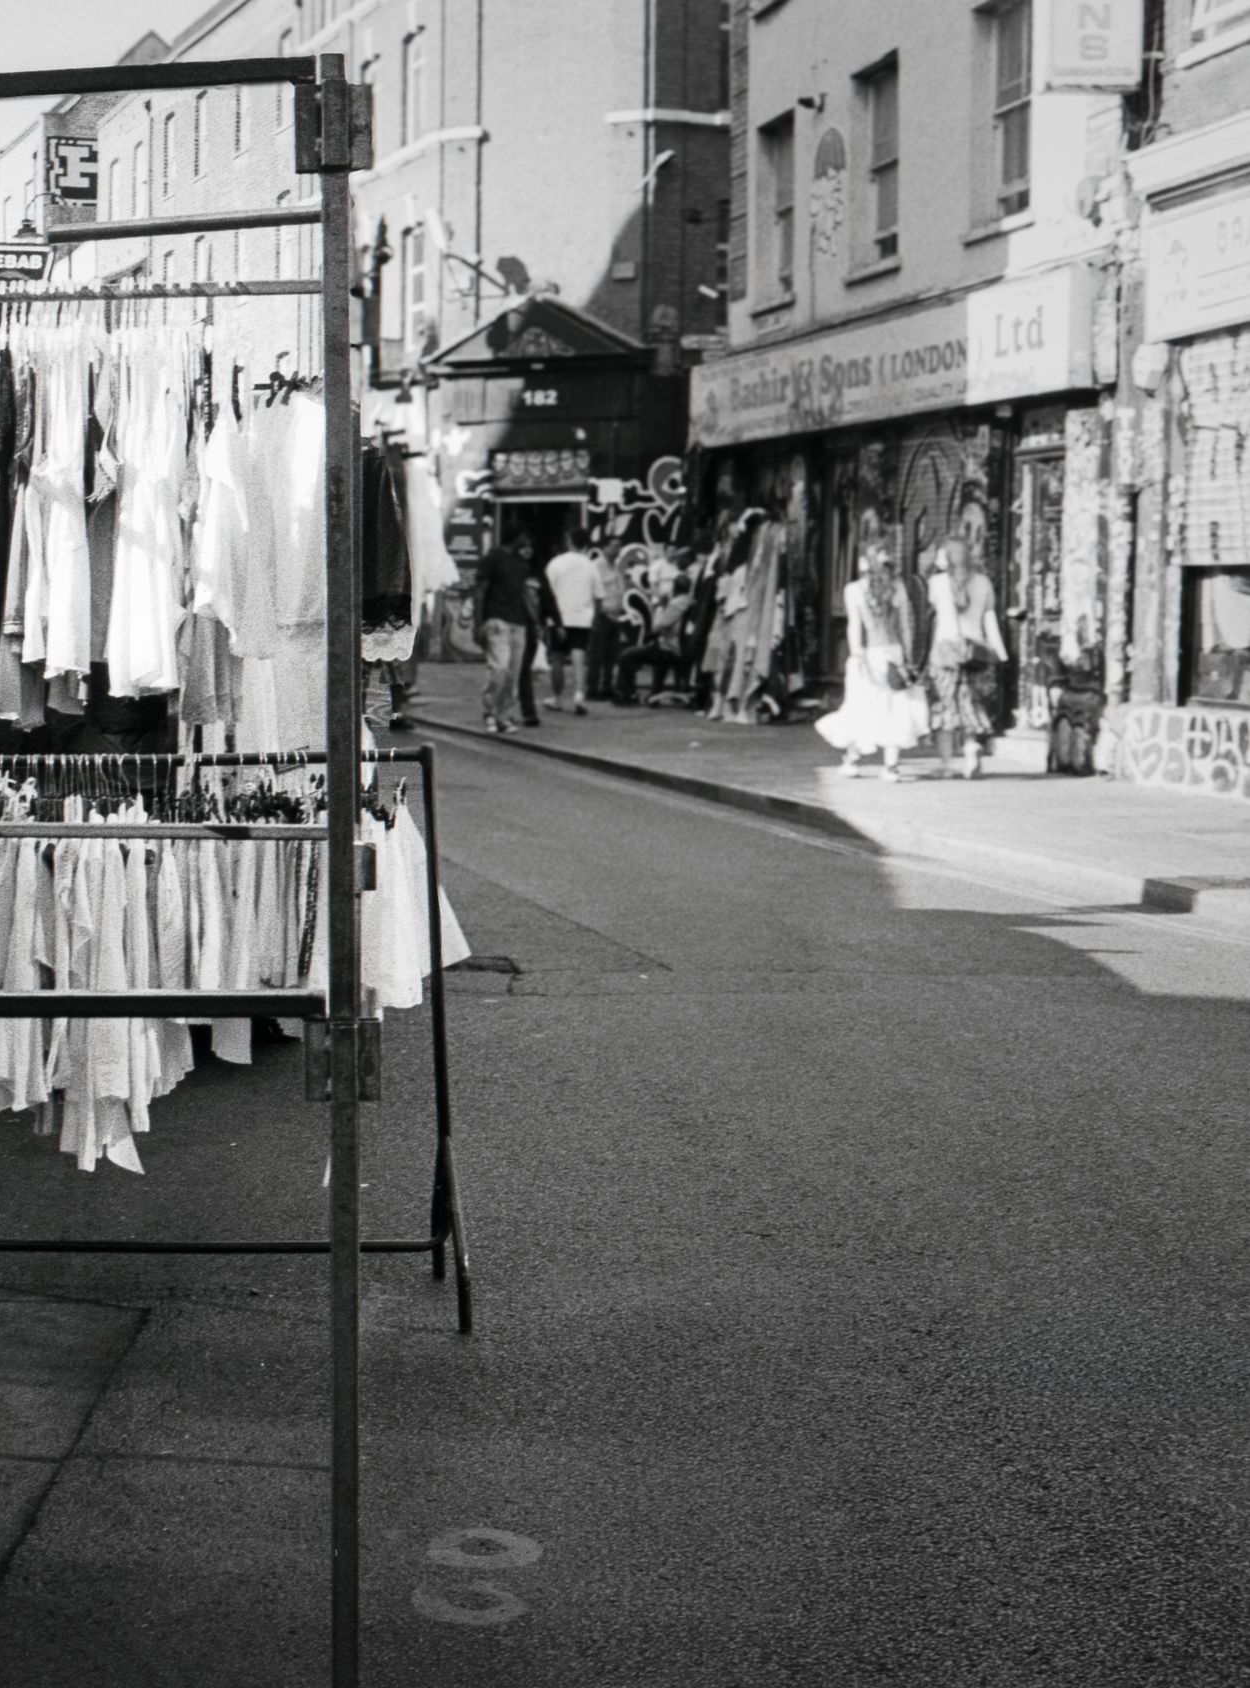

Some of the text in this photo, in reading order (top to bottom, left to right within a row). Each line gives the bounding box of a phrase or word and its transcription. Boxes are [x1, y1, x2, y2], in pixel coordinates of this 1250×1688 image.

[729, 365, 790, 412] Bashir
[819, 354, 872, 396] Sons
[993, 304, 1045, 358] Ltd
[523, 389, 558, 406] 182
